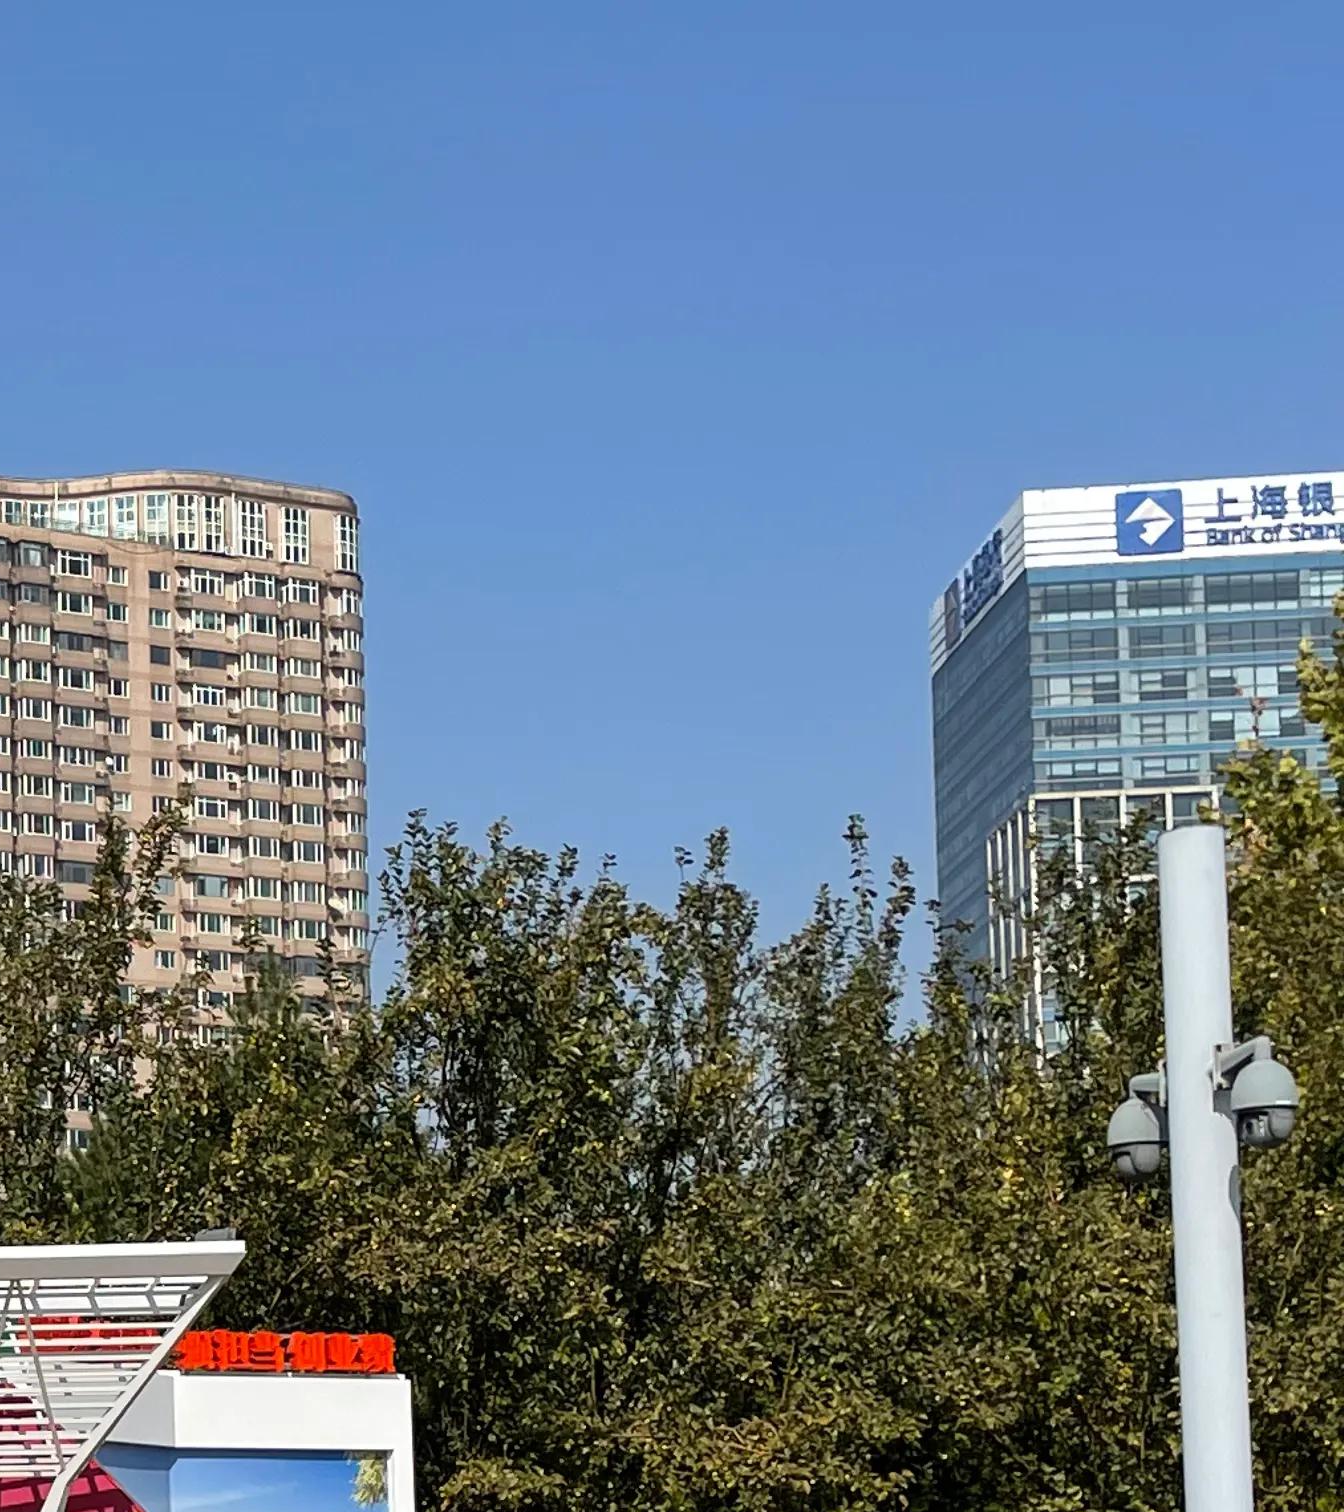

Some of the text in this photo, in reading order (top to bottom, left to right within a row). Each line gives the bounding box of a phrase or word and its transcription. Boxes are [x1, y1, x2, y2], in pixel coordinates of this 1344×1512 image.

[1204, 480, 1336, 524] 上海银
[1206, 526, 1257, 546] Bank
[1261, 523, 1283, 543] of
